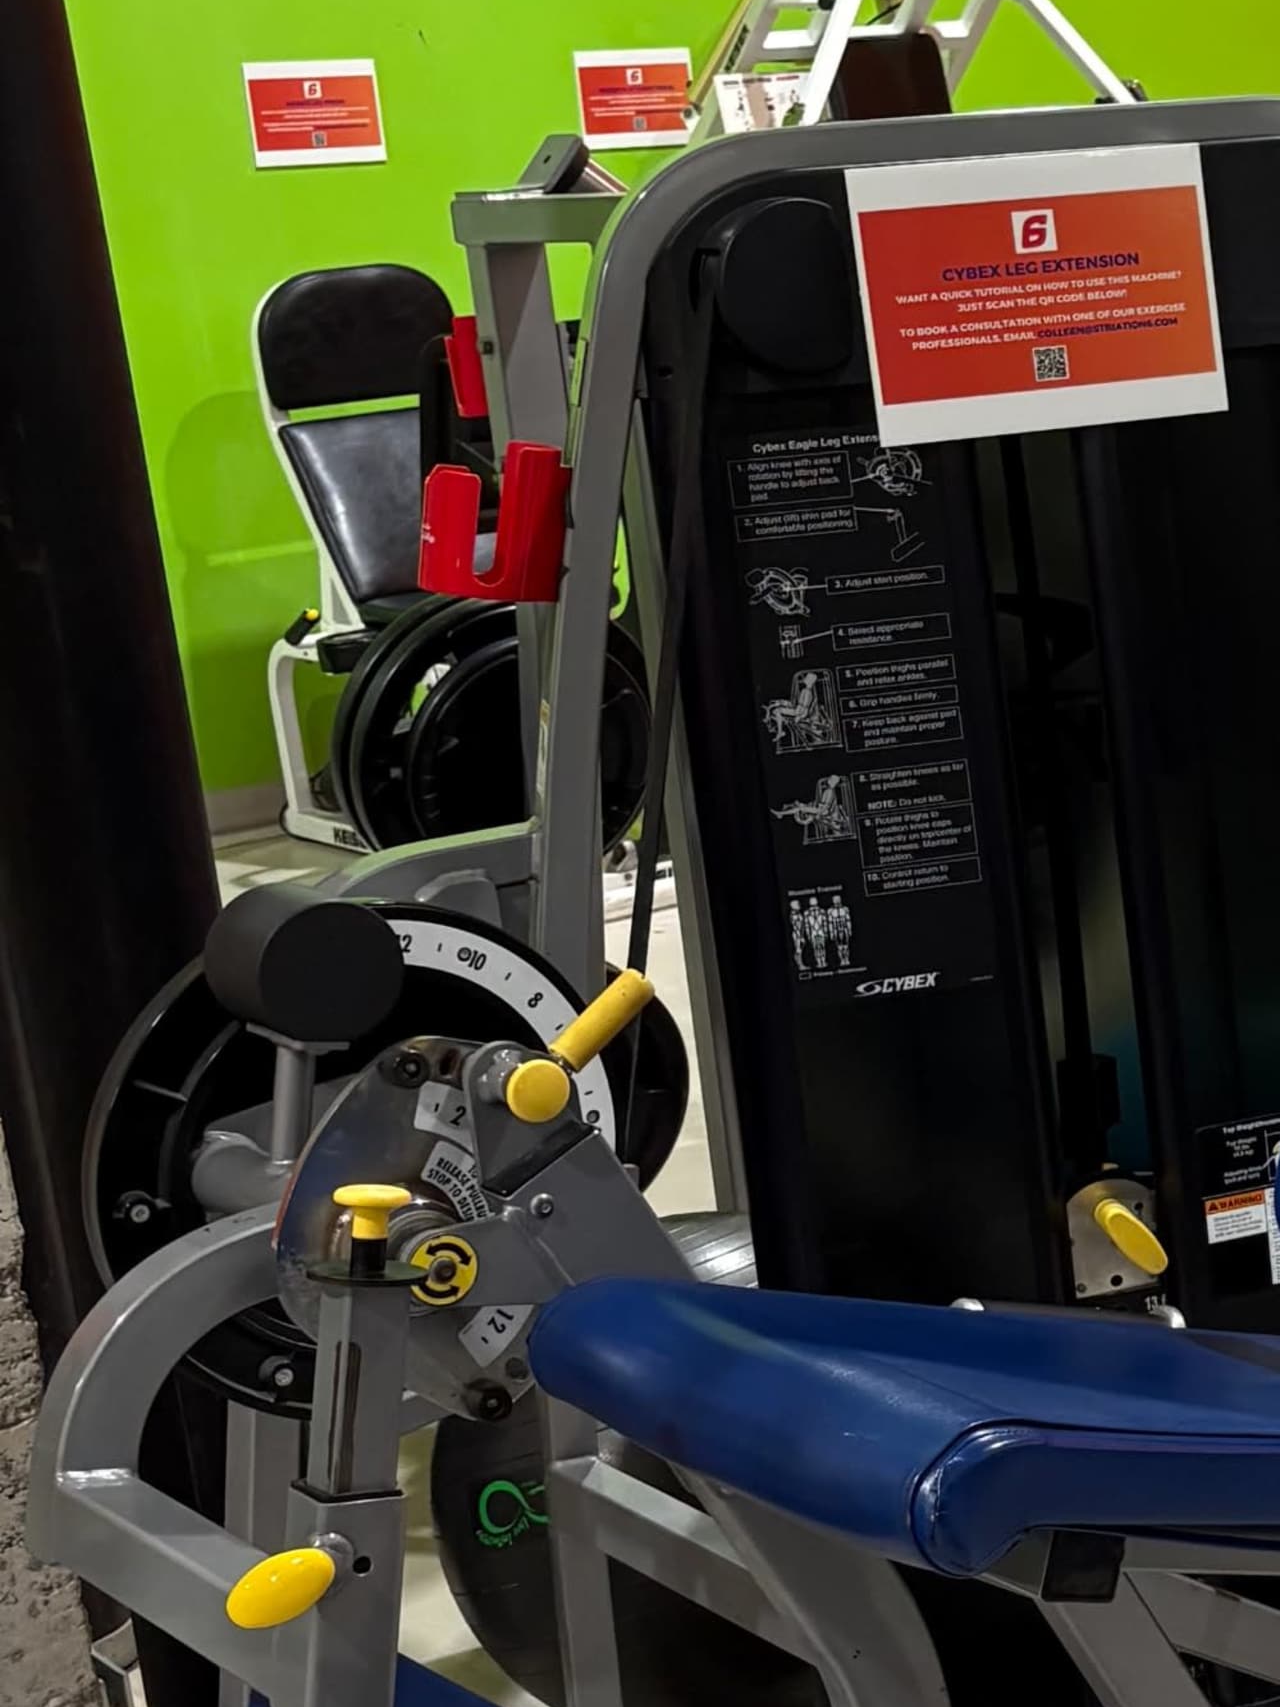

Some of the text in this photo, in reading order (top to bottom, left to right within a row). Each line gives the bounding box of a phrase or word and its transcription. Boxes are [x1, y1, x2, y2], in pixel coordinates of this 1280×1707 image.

[1022, 214, 1048, 249] 6
[942, 251, 1141, 282] CYBEX LEG EXTENSION
[896, 293, 929, 305] WANT
[930, 292, 939, 302] A
[940, 288, 974, 301] QUICK
[974, 284, 1025, 297] TUTORIAL
[1026, 282, 1042, 293] ON
[1042, 280, 1069, 291] HOW
[1069, 278, 1084, 288] TO
[1085, 276, 1106, 287] USE
[1107, 273, 1130, 285] THIS
[957, 302, 984, 313] JUST
[985, 300, 1015, 311] SCAN
[1015, 297, 1037, 308] THE
[1038, 296, 1056, 307] QR
[1056, 293, 1085, 305] CODE
[901, 302, 1187, 338] TO BOOK A CONSULTATION WITH ONE OF OUR EXERCISE
[1003, 330, 1036, 343] EMAIL
[752, 437, 840, 454] Cybex Eagle Leg
[469, 950, 487, 971] 10
[881, 972, 939, 995] CYBEX
[527, 991, 544, 1009] 8
[450, 1105, 467, 1126] 2
[427, 1168, 463, 1198] STOP TO
[437, 1157, 472, 1187] RELEASE
[1220, 1193, 1263, 1209] WARNING
[487, 1308, 514, 1335] 12
